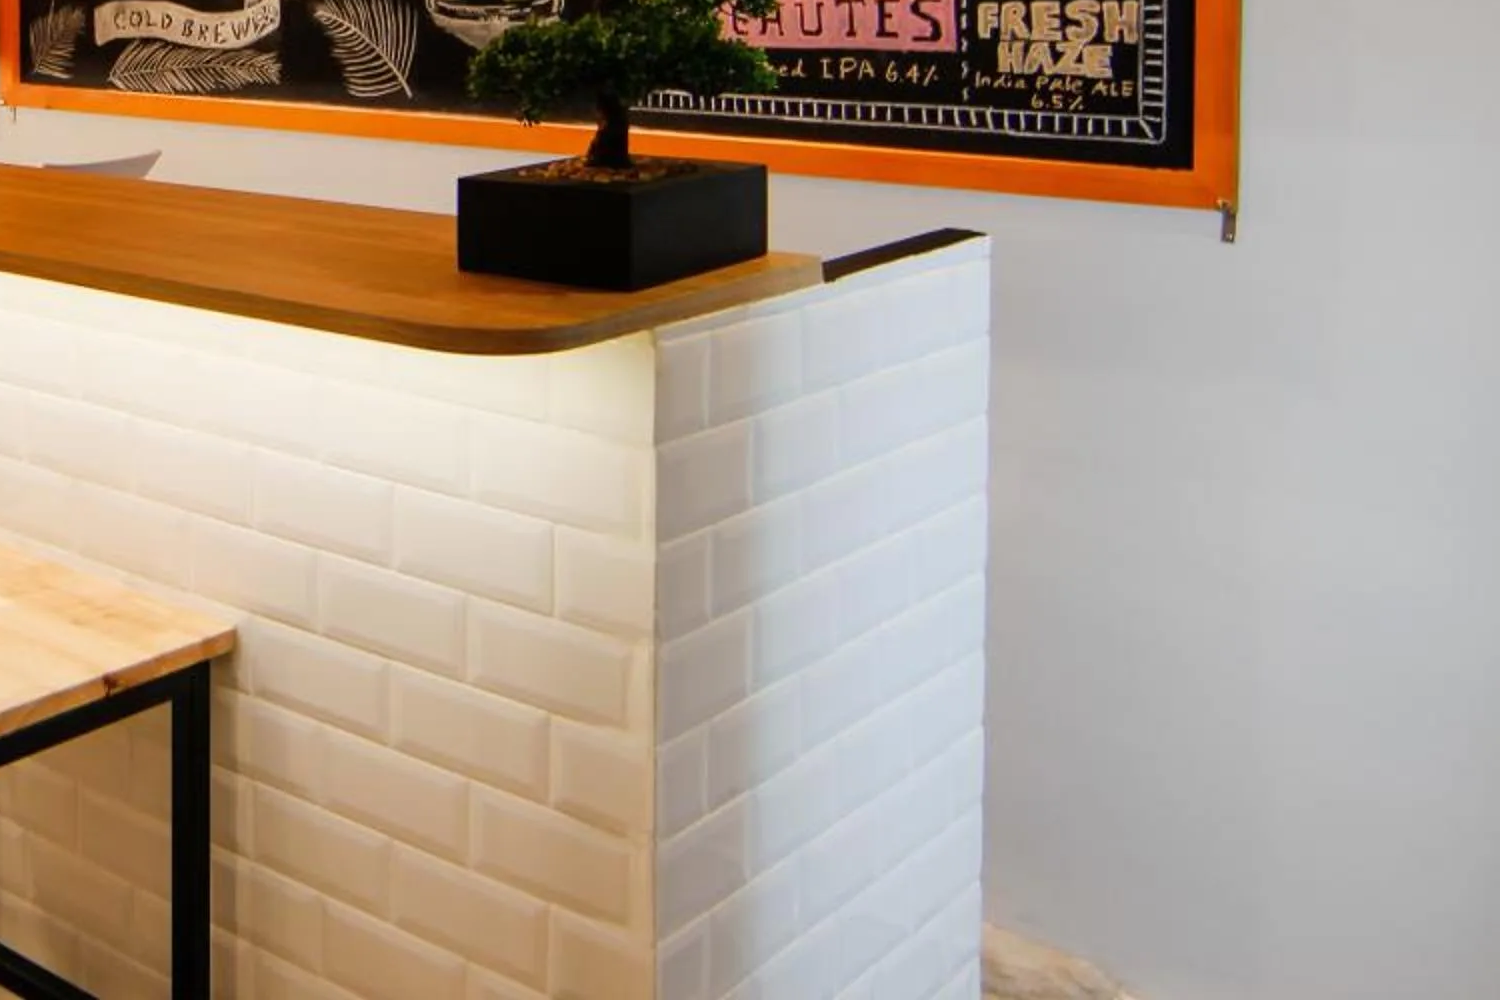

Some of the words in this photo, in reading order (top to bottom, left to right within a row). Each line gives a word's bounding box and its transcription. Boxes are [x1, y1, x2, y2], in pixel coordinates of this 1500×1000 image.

[113, 8, 173, 30] COLD
[820, 58, 875, 80] IPA
[997, 41, 1113, 79] HAZE
[1036, 74, 1084, 93] Pale
[1091, 79, 1135, 98] ALE
